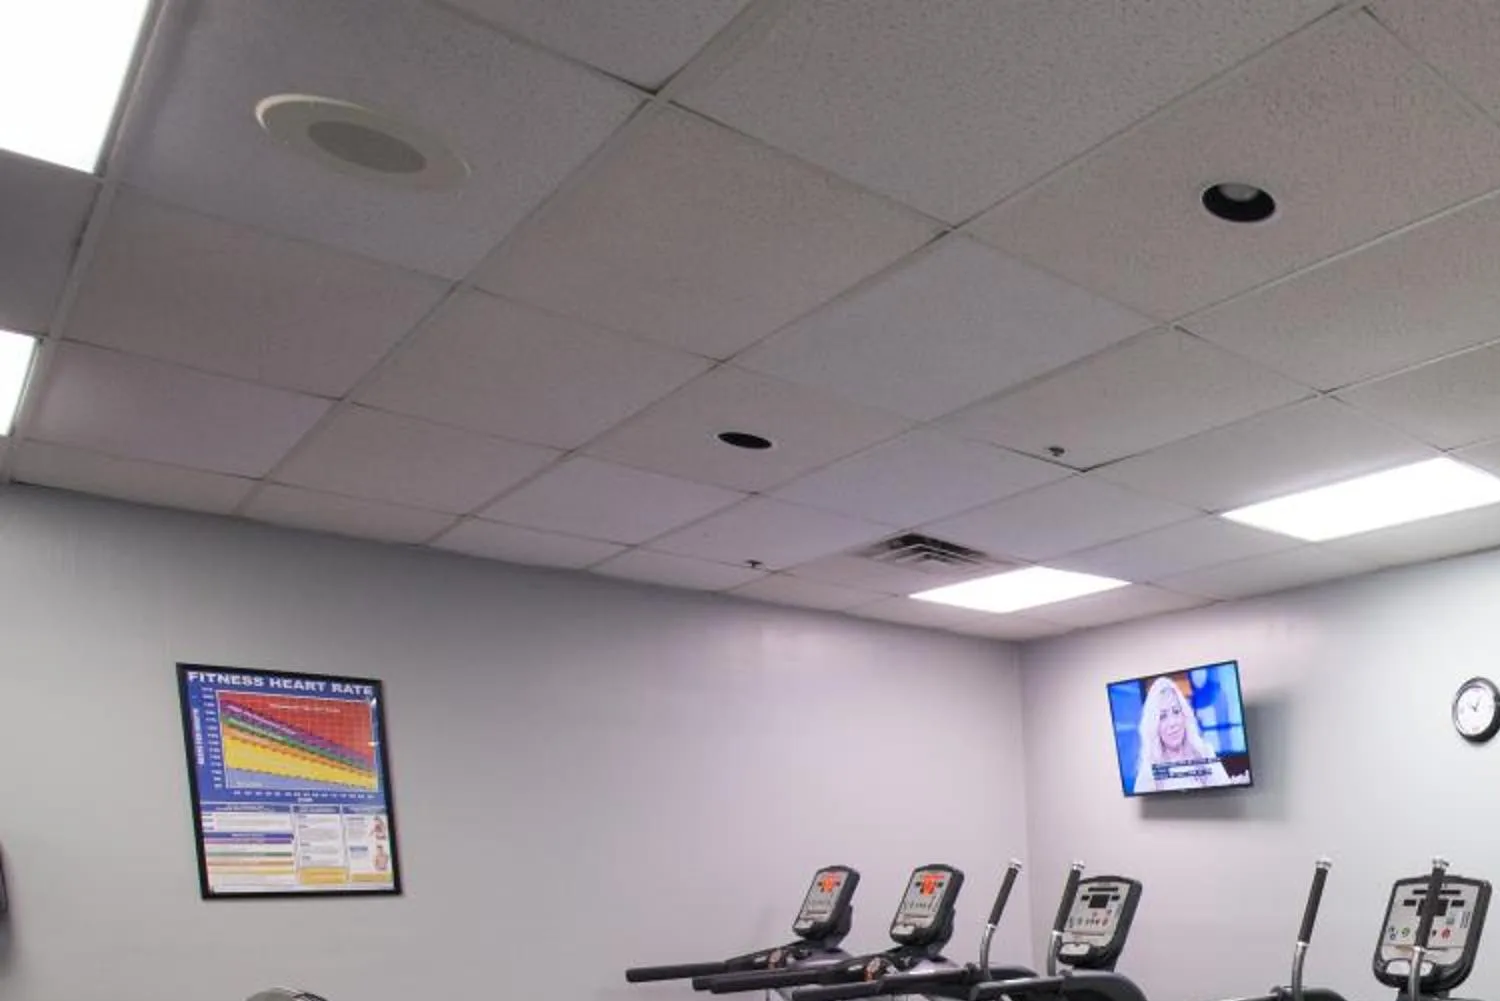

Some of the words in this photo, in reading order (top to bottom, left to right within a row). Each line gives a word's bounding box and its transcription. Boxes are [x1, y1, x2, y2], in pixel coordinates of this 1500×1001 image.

[187, 671, 264, 687] FITNESS
[269, 678, 327, 692] HEART
[331, 683, 373, 695] RATE
